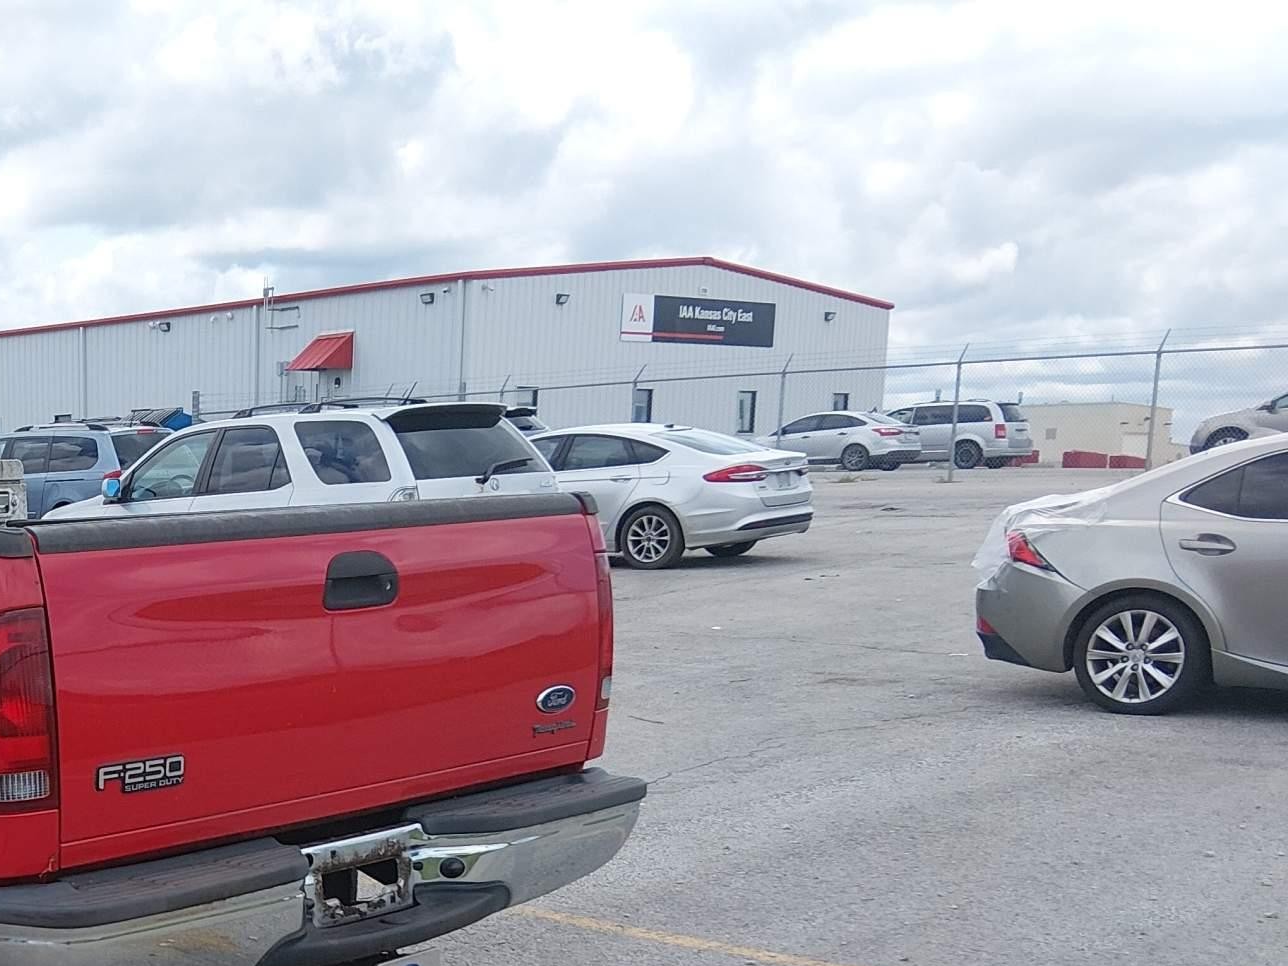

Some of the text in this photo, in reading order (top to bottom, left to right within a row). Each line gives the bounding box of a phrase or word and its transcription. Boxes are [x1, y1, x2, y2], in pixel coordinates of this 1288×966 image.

[679, 305, 753, 324] IAA Kansas City East
[124, 777, 185, 792] SUPER DUTY
